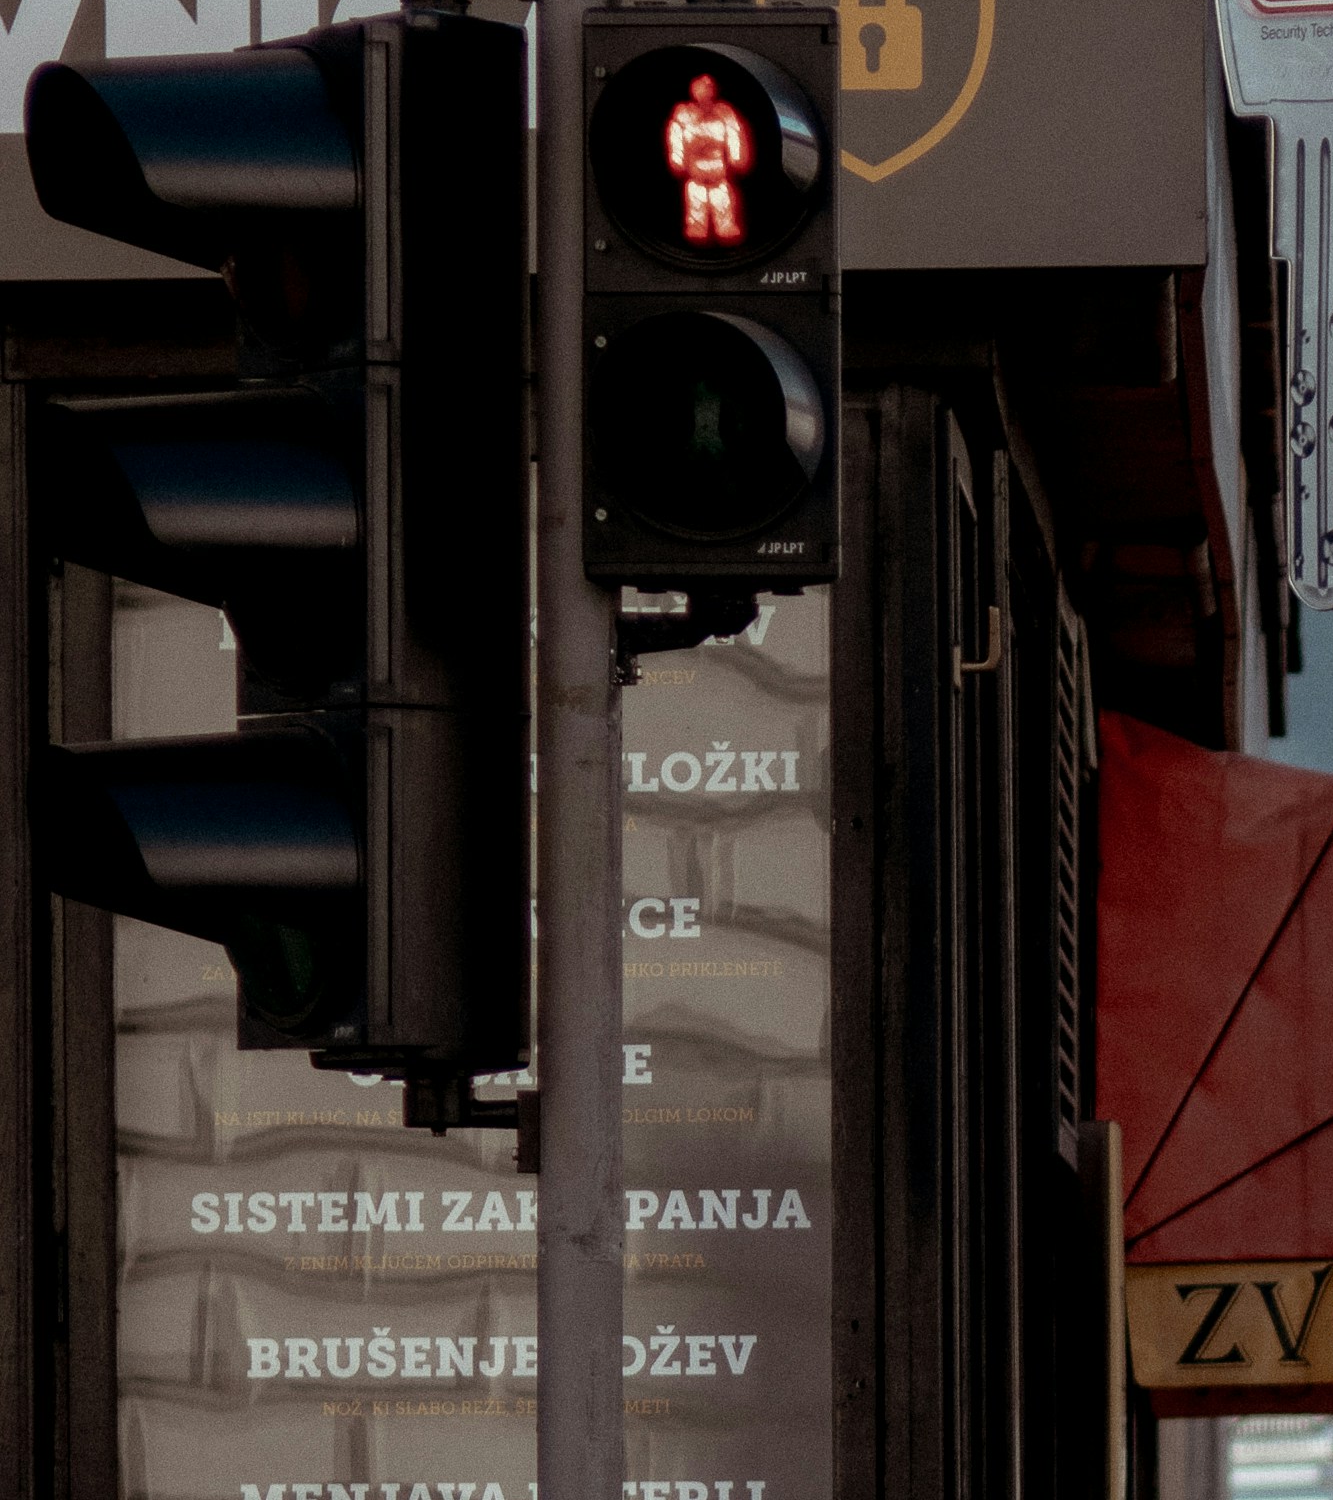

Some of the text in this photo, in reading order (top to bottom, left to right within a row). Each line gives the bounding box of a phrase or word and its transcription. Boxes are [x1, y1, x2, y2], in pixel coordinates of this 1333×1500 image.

[1260, 25, 1308, 41] Security
[622, 741, 799, 792] LOŽKI
[623, 962, 663, 977] HKO
[622, 1108, 680, 1122] OLGIM
[191, 1188, 812, 1234] SISTEMI ZAKPANJA
[246, 1325, 757, 1378] BRUŠENJE OŽEV
